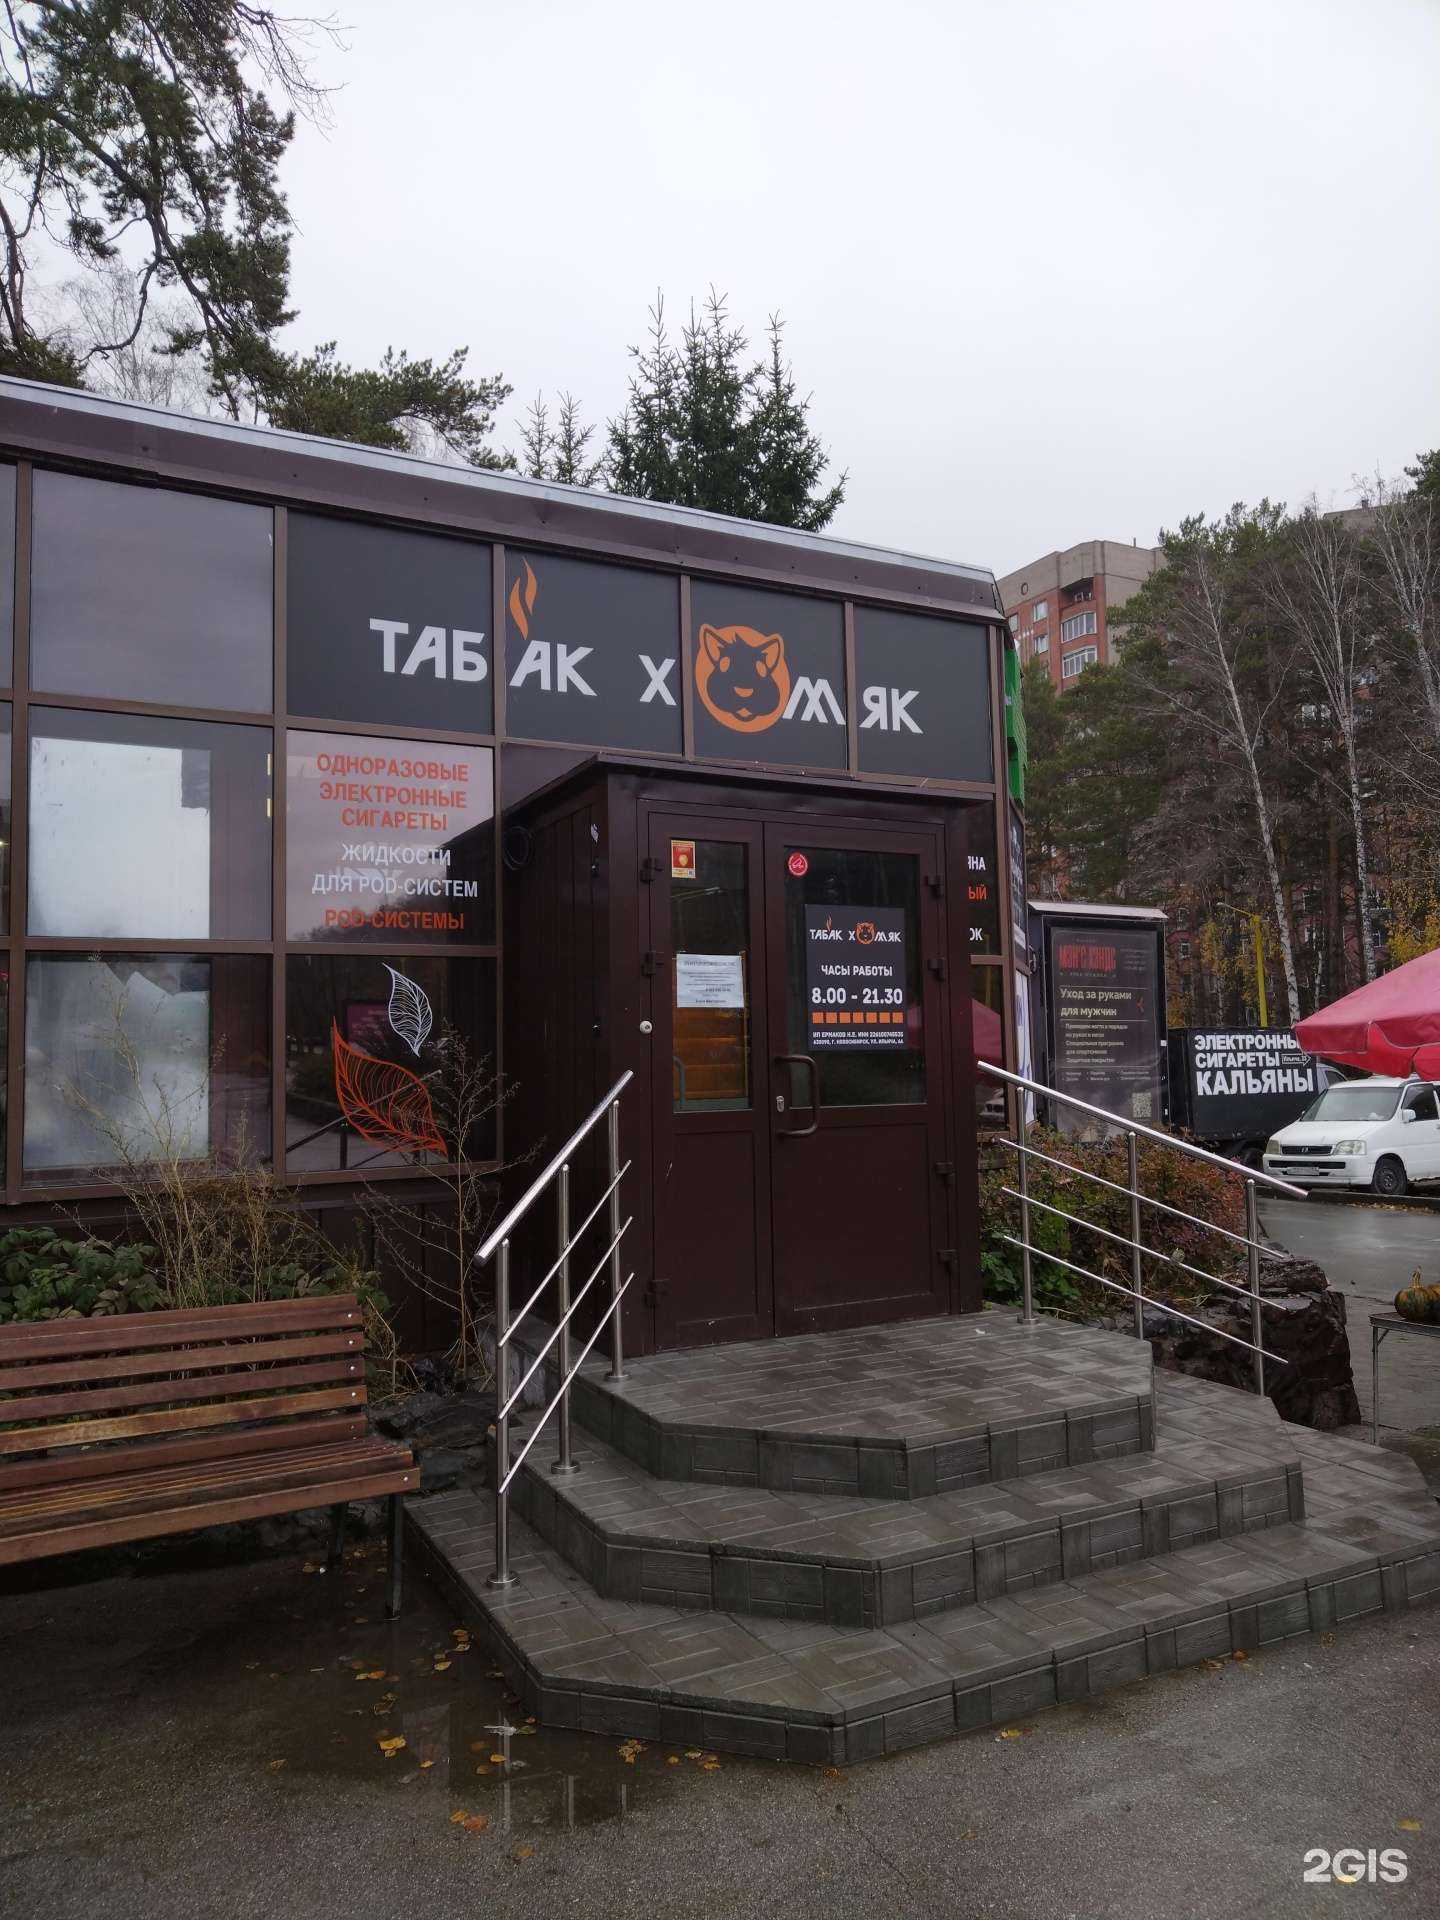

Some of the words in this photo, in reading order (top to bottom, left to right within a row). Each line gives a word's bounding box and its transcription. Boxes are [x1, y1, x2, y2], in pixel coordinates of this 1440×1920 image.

[369, 617, 598, 697] ТАБАК
[317, 753, 469, 782] ОДНОРАЗОВЫЕ
[319, 781, 467, 808] ЭЛЕКТРОННЫЕ
[342, 807, 448, 831] СИГАРЕТЫ
[342, 843, 451, 867] ЖИДКОСТИ
[312, 874, 352, 895] ДЛЯ
[359, 876, 478, 898] POD-СИСТЕМ
[325, 909, 464, 930] POD-СИСТЕМЫ
[810, 929, 843, 941] ТАБАК
[821, 965, 850, 976] ЧАСЫ
[853, 965, 893, 977] РАБОТЫ
[811, 987, 847, 1004] 8.00
[862, 988, 903, 1004] 21.30
[1060, 988, 1084, 1000] Уход
[1086, 991, 1096, 999] за
[1098, 991, 1132, 1002] руками
[1060, 1006, 1079, 1017] для
[1080, 1007, 1117, 1017] мужчин
[1194, 1034, 1300, 1050] ЭЛЕКТРОННЫ
[1195, 1052, 1280, 1068] СИГАРЕТЫ
[1196, 1068, 1314, 1096] КАЛЬЯНЫ
